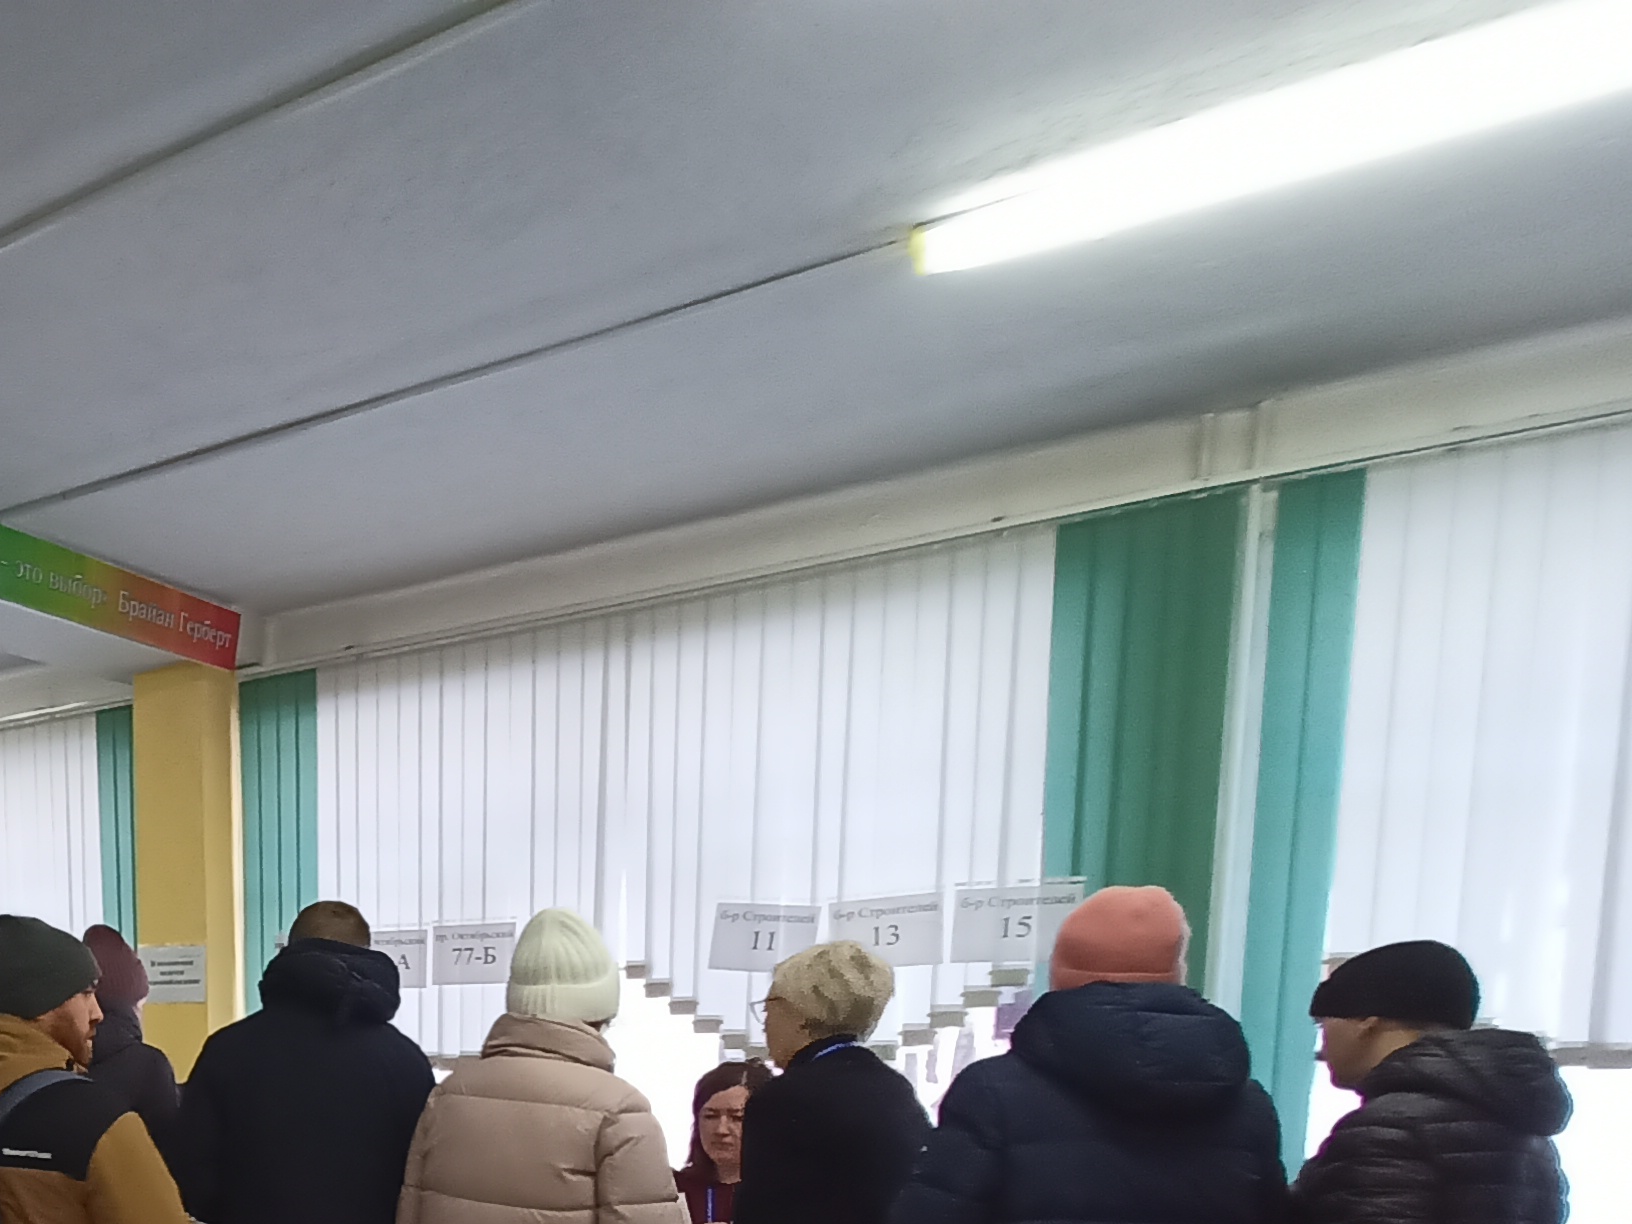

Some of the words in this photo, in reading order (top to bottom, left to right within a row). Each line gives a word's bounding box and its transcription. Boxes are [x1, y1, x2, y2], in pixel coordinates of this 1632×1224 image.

[16, 560, 44, 585] это
[117, 589, 175, 629] Брайан
[177, 610, 233, 649] Герберт
[872, 924, 901, 947] 13
[1001, 915, 1033, 939] 15
[751, 930, 777, 951] 11
[451, 946, 497, 966] 77-Б
